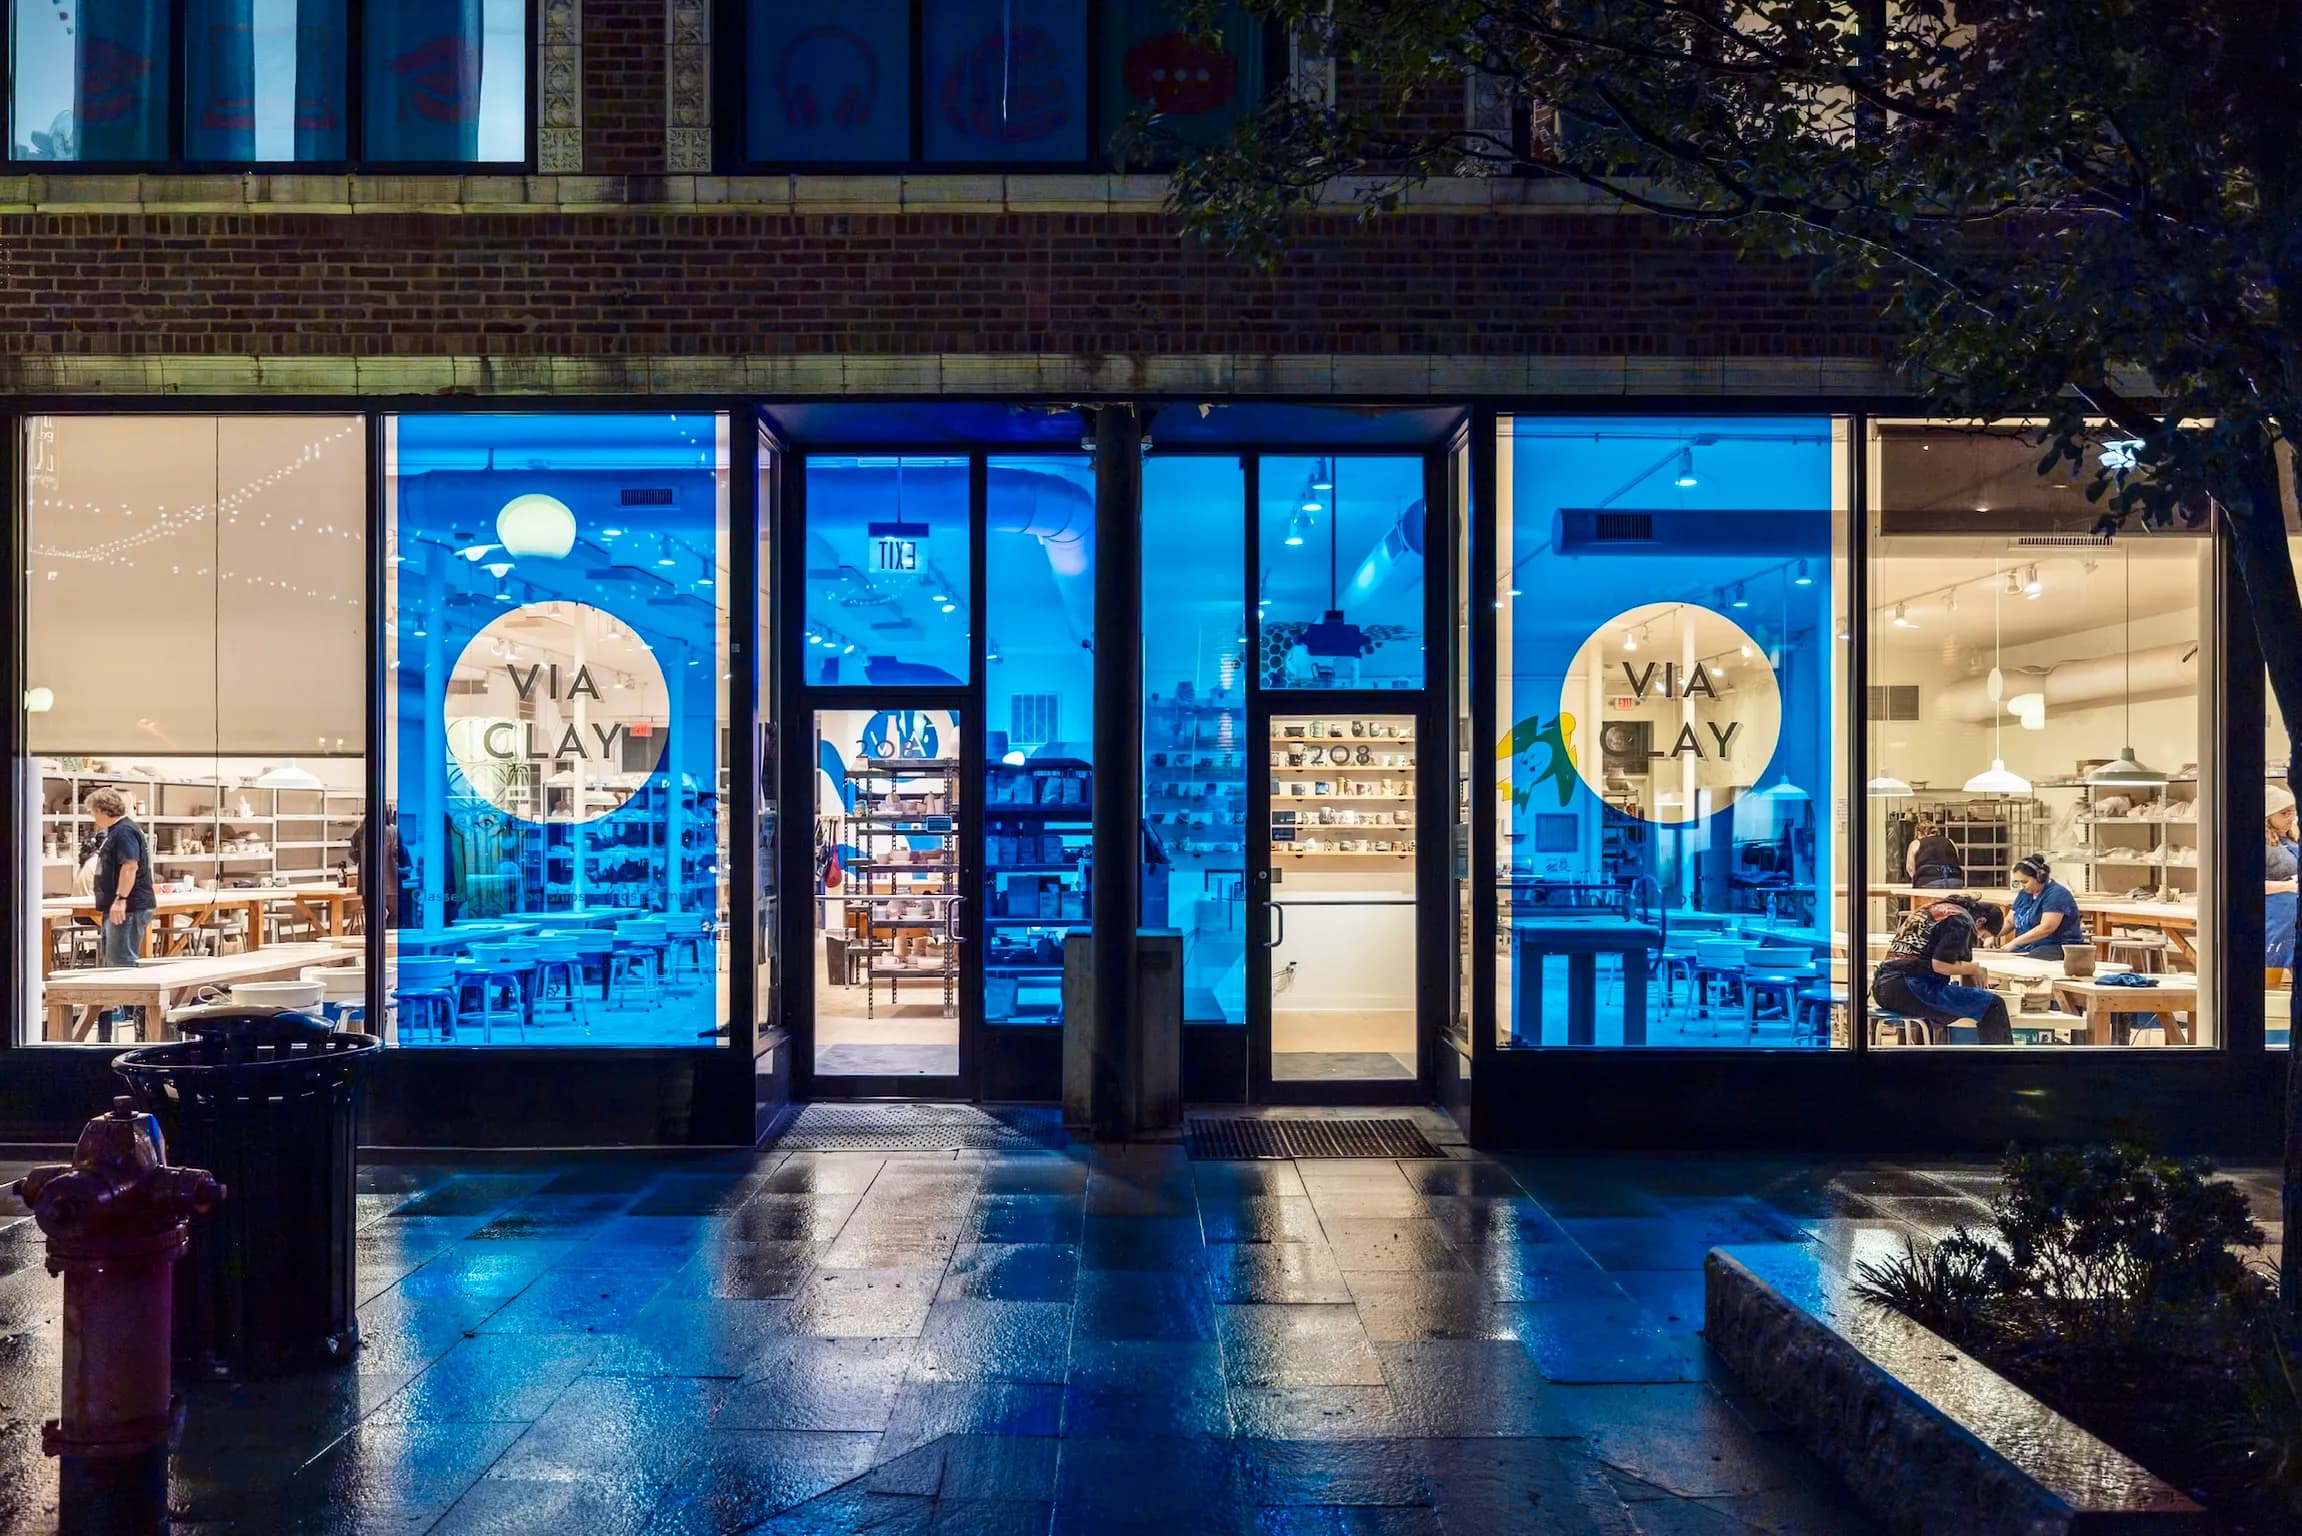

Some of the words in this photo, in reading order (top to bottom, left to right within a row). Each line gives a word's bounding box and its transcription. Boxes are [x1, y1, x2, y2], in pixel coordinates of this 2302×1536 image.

[507, 664, 601, 700] VIA
[1622, 662, 1717, 698] VIA
[484, 723, 622, 759] CLAY
[1310, 745, 1371, 766] 208
[1600, 721, 1739, 758] CLAY
